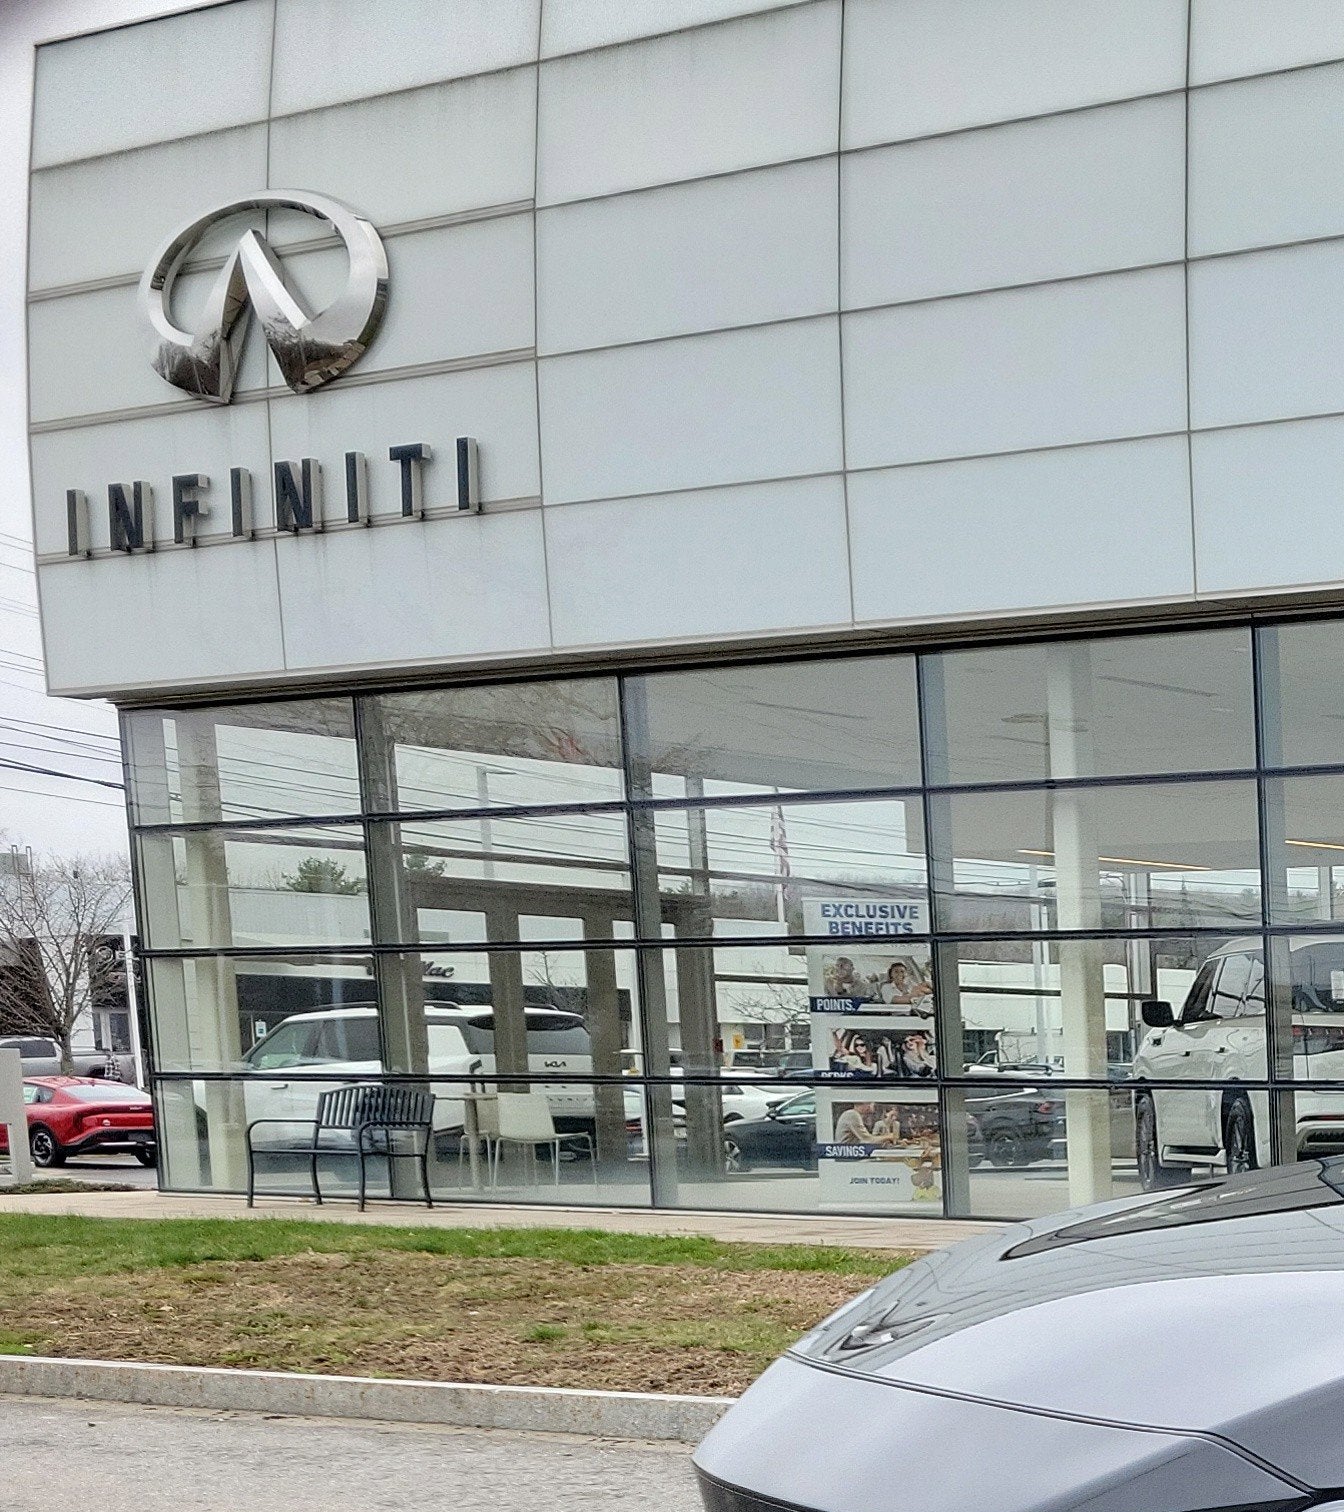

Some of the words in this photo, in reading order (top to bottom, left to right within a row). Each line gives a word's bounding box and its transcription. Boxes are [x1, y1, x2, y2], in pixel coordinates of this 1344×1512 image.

[66, 436, 480, 556] INFINITI
[820, 903, 920, 920] EXCLUSIVE
[828, 920, 914, 936] BENEFITS
[850, 1176, 868, 1185] JOIN
